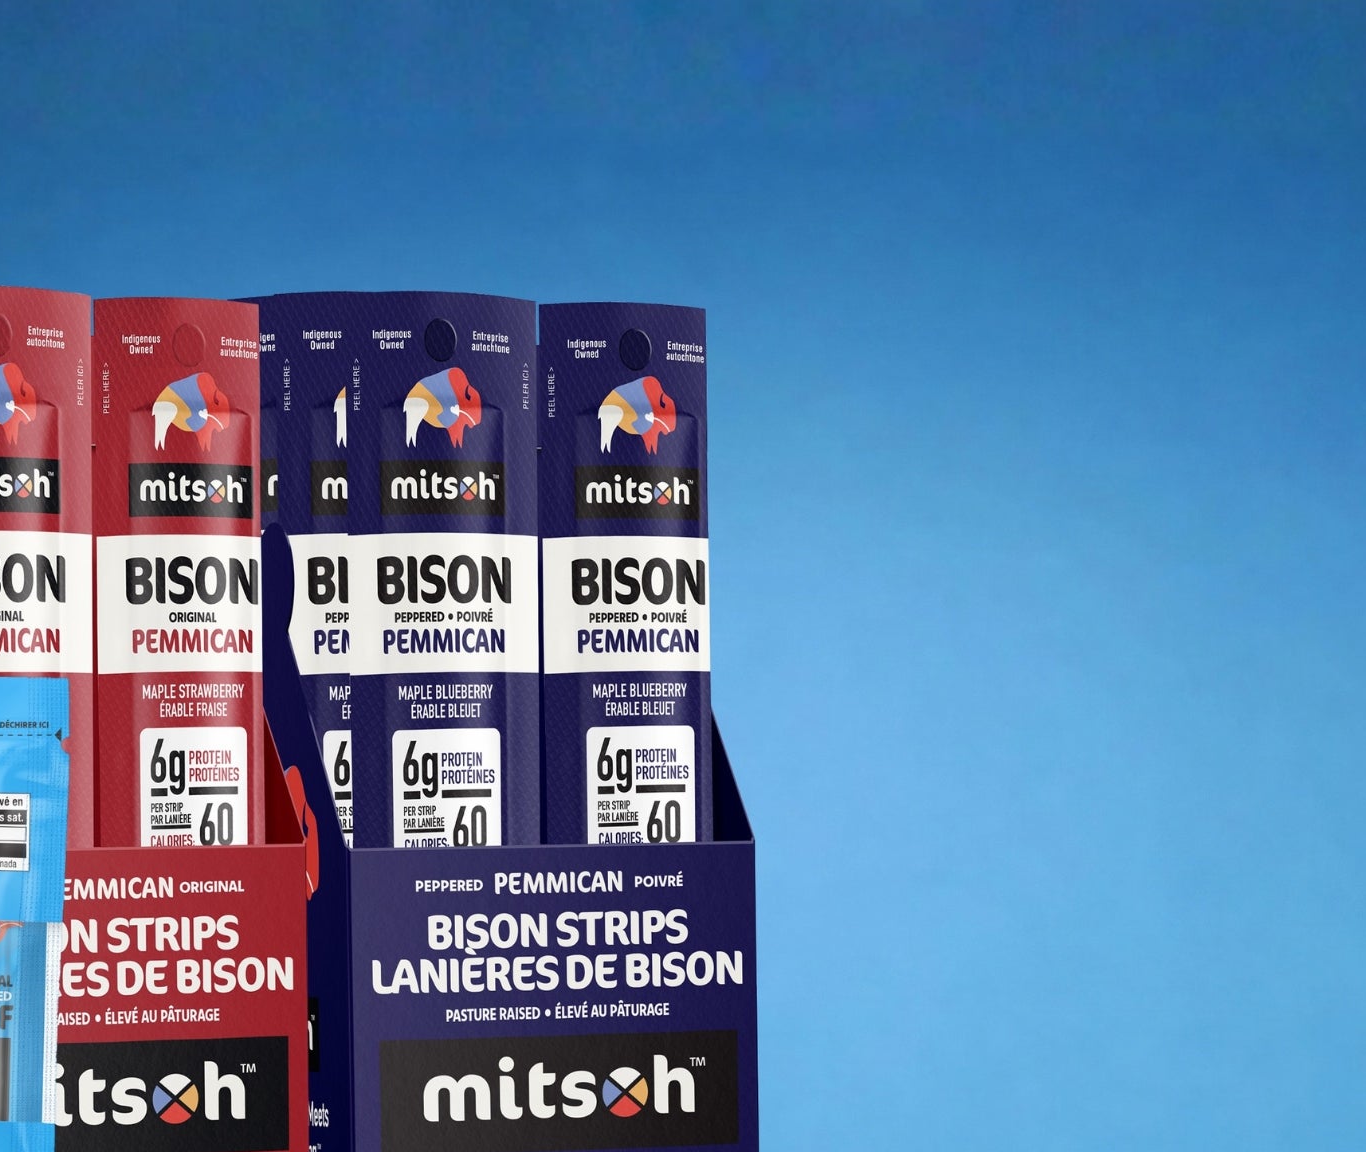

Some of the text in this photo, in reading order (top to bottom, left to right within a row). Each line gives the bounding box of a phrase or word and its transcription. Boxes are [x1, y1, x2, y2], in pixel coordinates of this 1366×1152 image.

[121, 333, 160, 344] Indigenous
[221, 335, 257, 349] Entreprise
[128, 343, 154, 354] Owned
[220, 346, 258, 358] autochtone
[125, 556, 259, 605] BISON
[377, 553, 512, 604] BISON
[571, 557, 706, 605] BISON
[169, 611, 216, 623] ORIGINAL
[589, 608, 687, 623] PEPPERED POIVRÉ
[132, 629, 253, 654] PEMMICAN
[383, 628, 505, 654] PEMMICAN
[577, 629, 699, 654] PEMMICAN
[142, 682, 244, 699] MAPLE STRAWBERRY
[592, 681, 687, 699] MAPLE BLUEBERRY
[160, 699, 227, 717] ÉRABLE FRAISE
[605, 698, 675, 716] ÉRABLE BLEUET
[0, 719, 49, 728] DÉCHIRER ICI
[12, 797, 23, 805] en
[7, 812, 24, 821] sat.
[179, 879, 245, 893] ORIGINAL
[416, 870, 684, 893] PEPPERED PEMMICAN POIVRÉ
[107, 914, 239, 953] STRIPS
[427, 909, 688, 950] BISON STRIPS
[117, 956, 294, 994] DE BISON
[372, 947, 744, 993] LANIÈRES DE BISON
